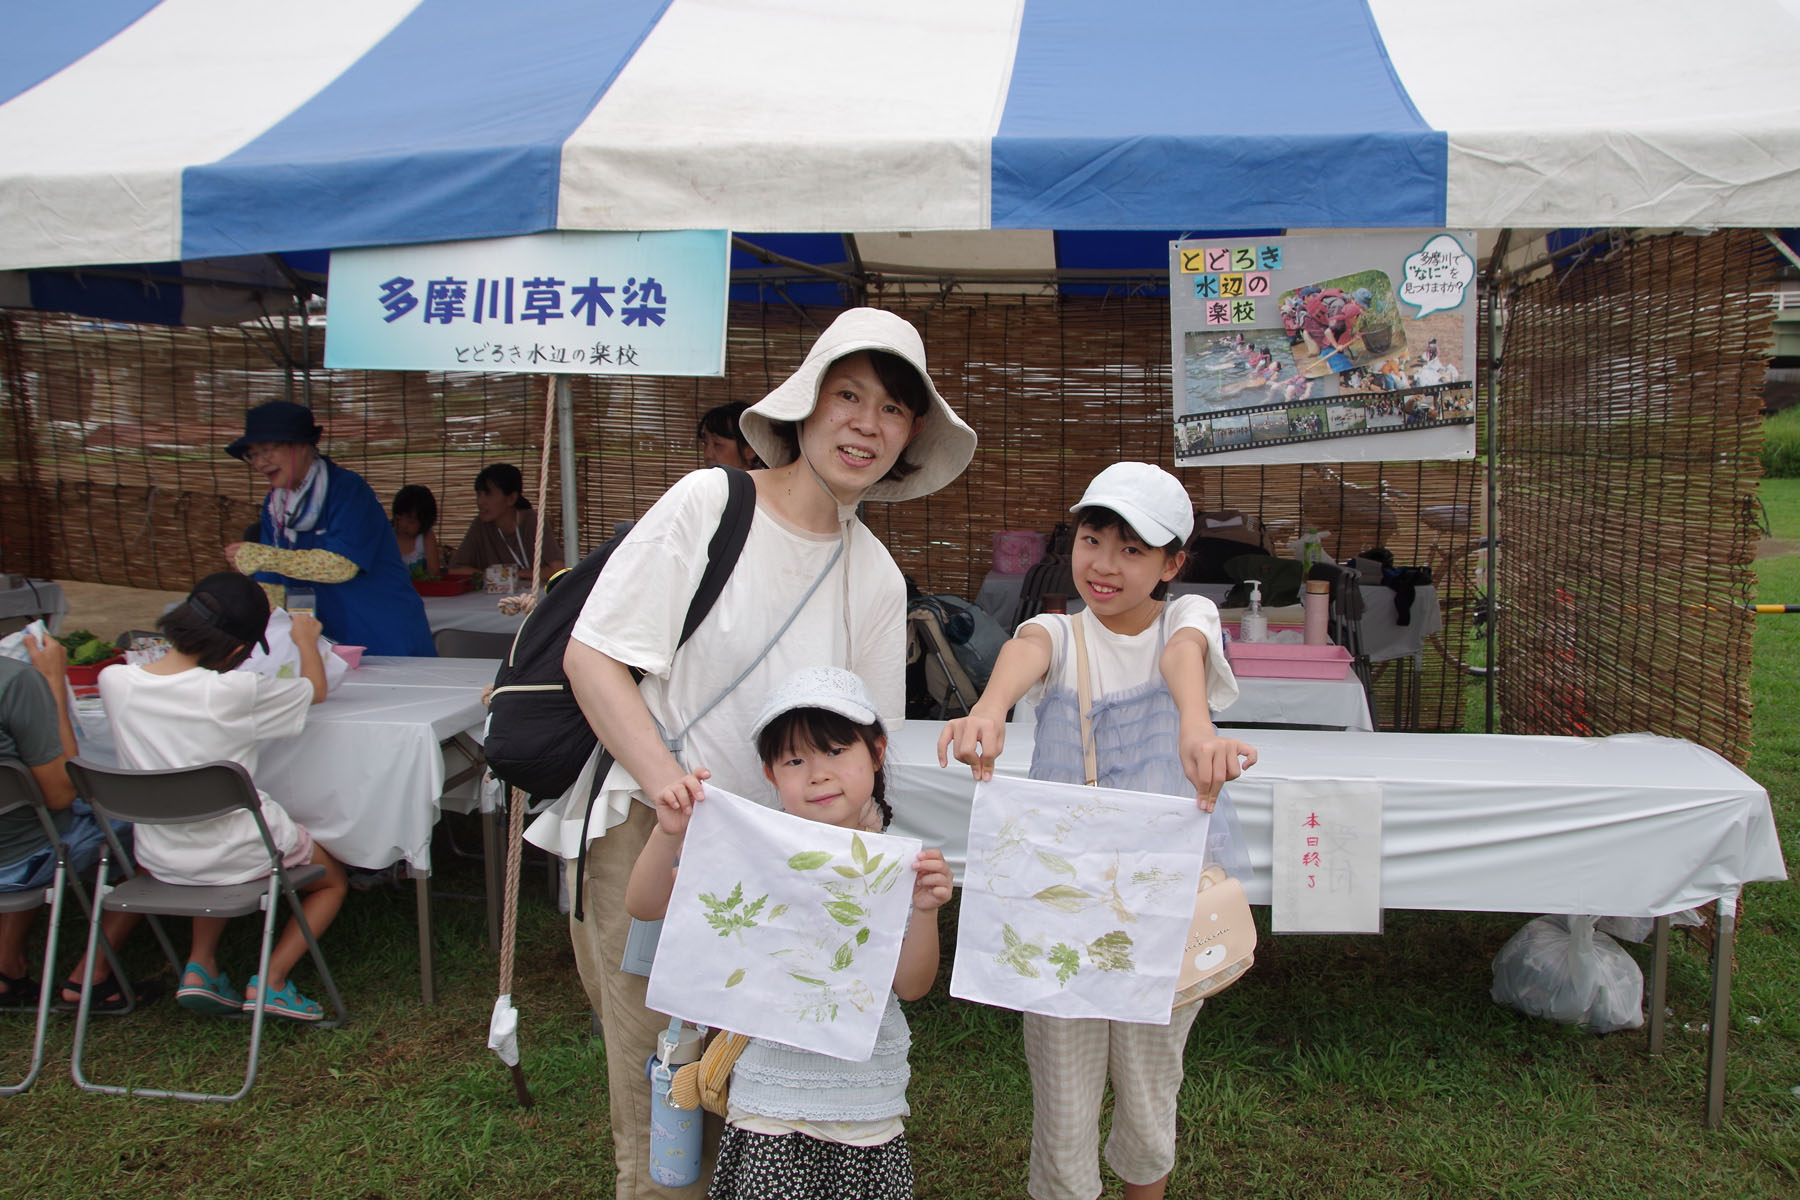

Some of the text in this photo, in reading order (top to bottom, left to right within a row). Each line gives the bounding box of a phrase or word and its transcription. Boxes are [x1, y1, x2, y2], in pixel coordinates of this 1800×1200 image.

[1182, 246, 1280, 272] とどろき
[1420, 249, 1466, 267] 多摩川で
[1196, 275, 1268, 298] 水辺の
[1404, 280, 1464, 295] 見つけますか?
[378, 276, 667, 328] 多摩川草木染
[1208, 300, 1256, 324] 楽校
[455, 341, 641, 367] とどろき水辺の楽校
[1301, 811, 1321, 889] 本日終了
